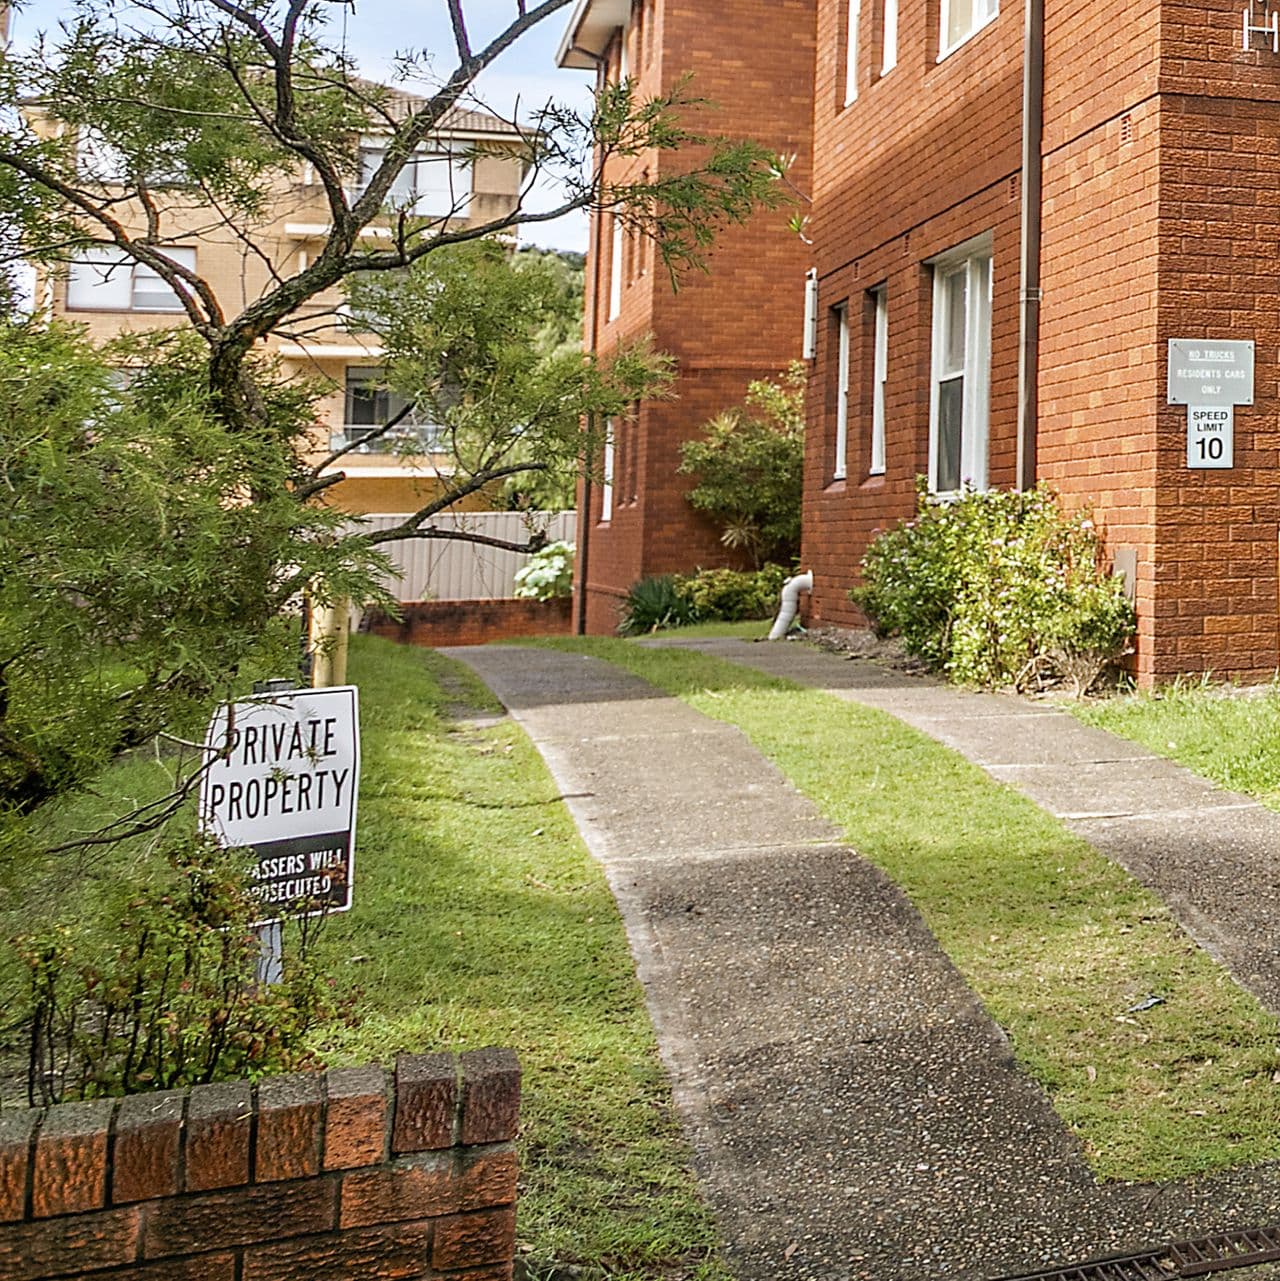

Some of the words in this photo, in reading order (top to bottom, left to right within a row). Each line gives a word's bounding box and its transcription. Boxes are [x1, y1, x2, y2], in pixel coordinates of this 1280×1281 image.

[1204, 350, 1235, 360] TRUCKS
[1177, 369, 1221, 378] RESIDENTS
[1224, 370, 1245, 379] CARS
[1201, 385, 1221, 394] ONLY
[1193, 411, 1228, 421] SPEED
[1197, 423, 1224, 432] LIMIT
[1196, 437, 1224, 460] 10
[225, 718, 337, 768] PRIVATE
[210, 768, 349, 823] PROPERTY
[248, 853, 305, 880] ASSERS
